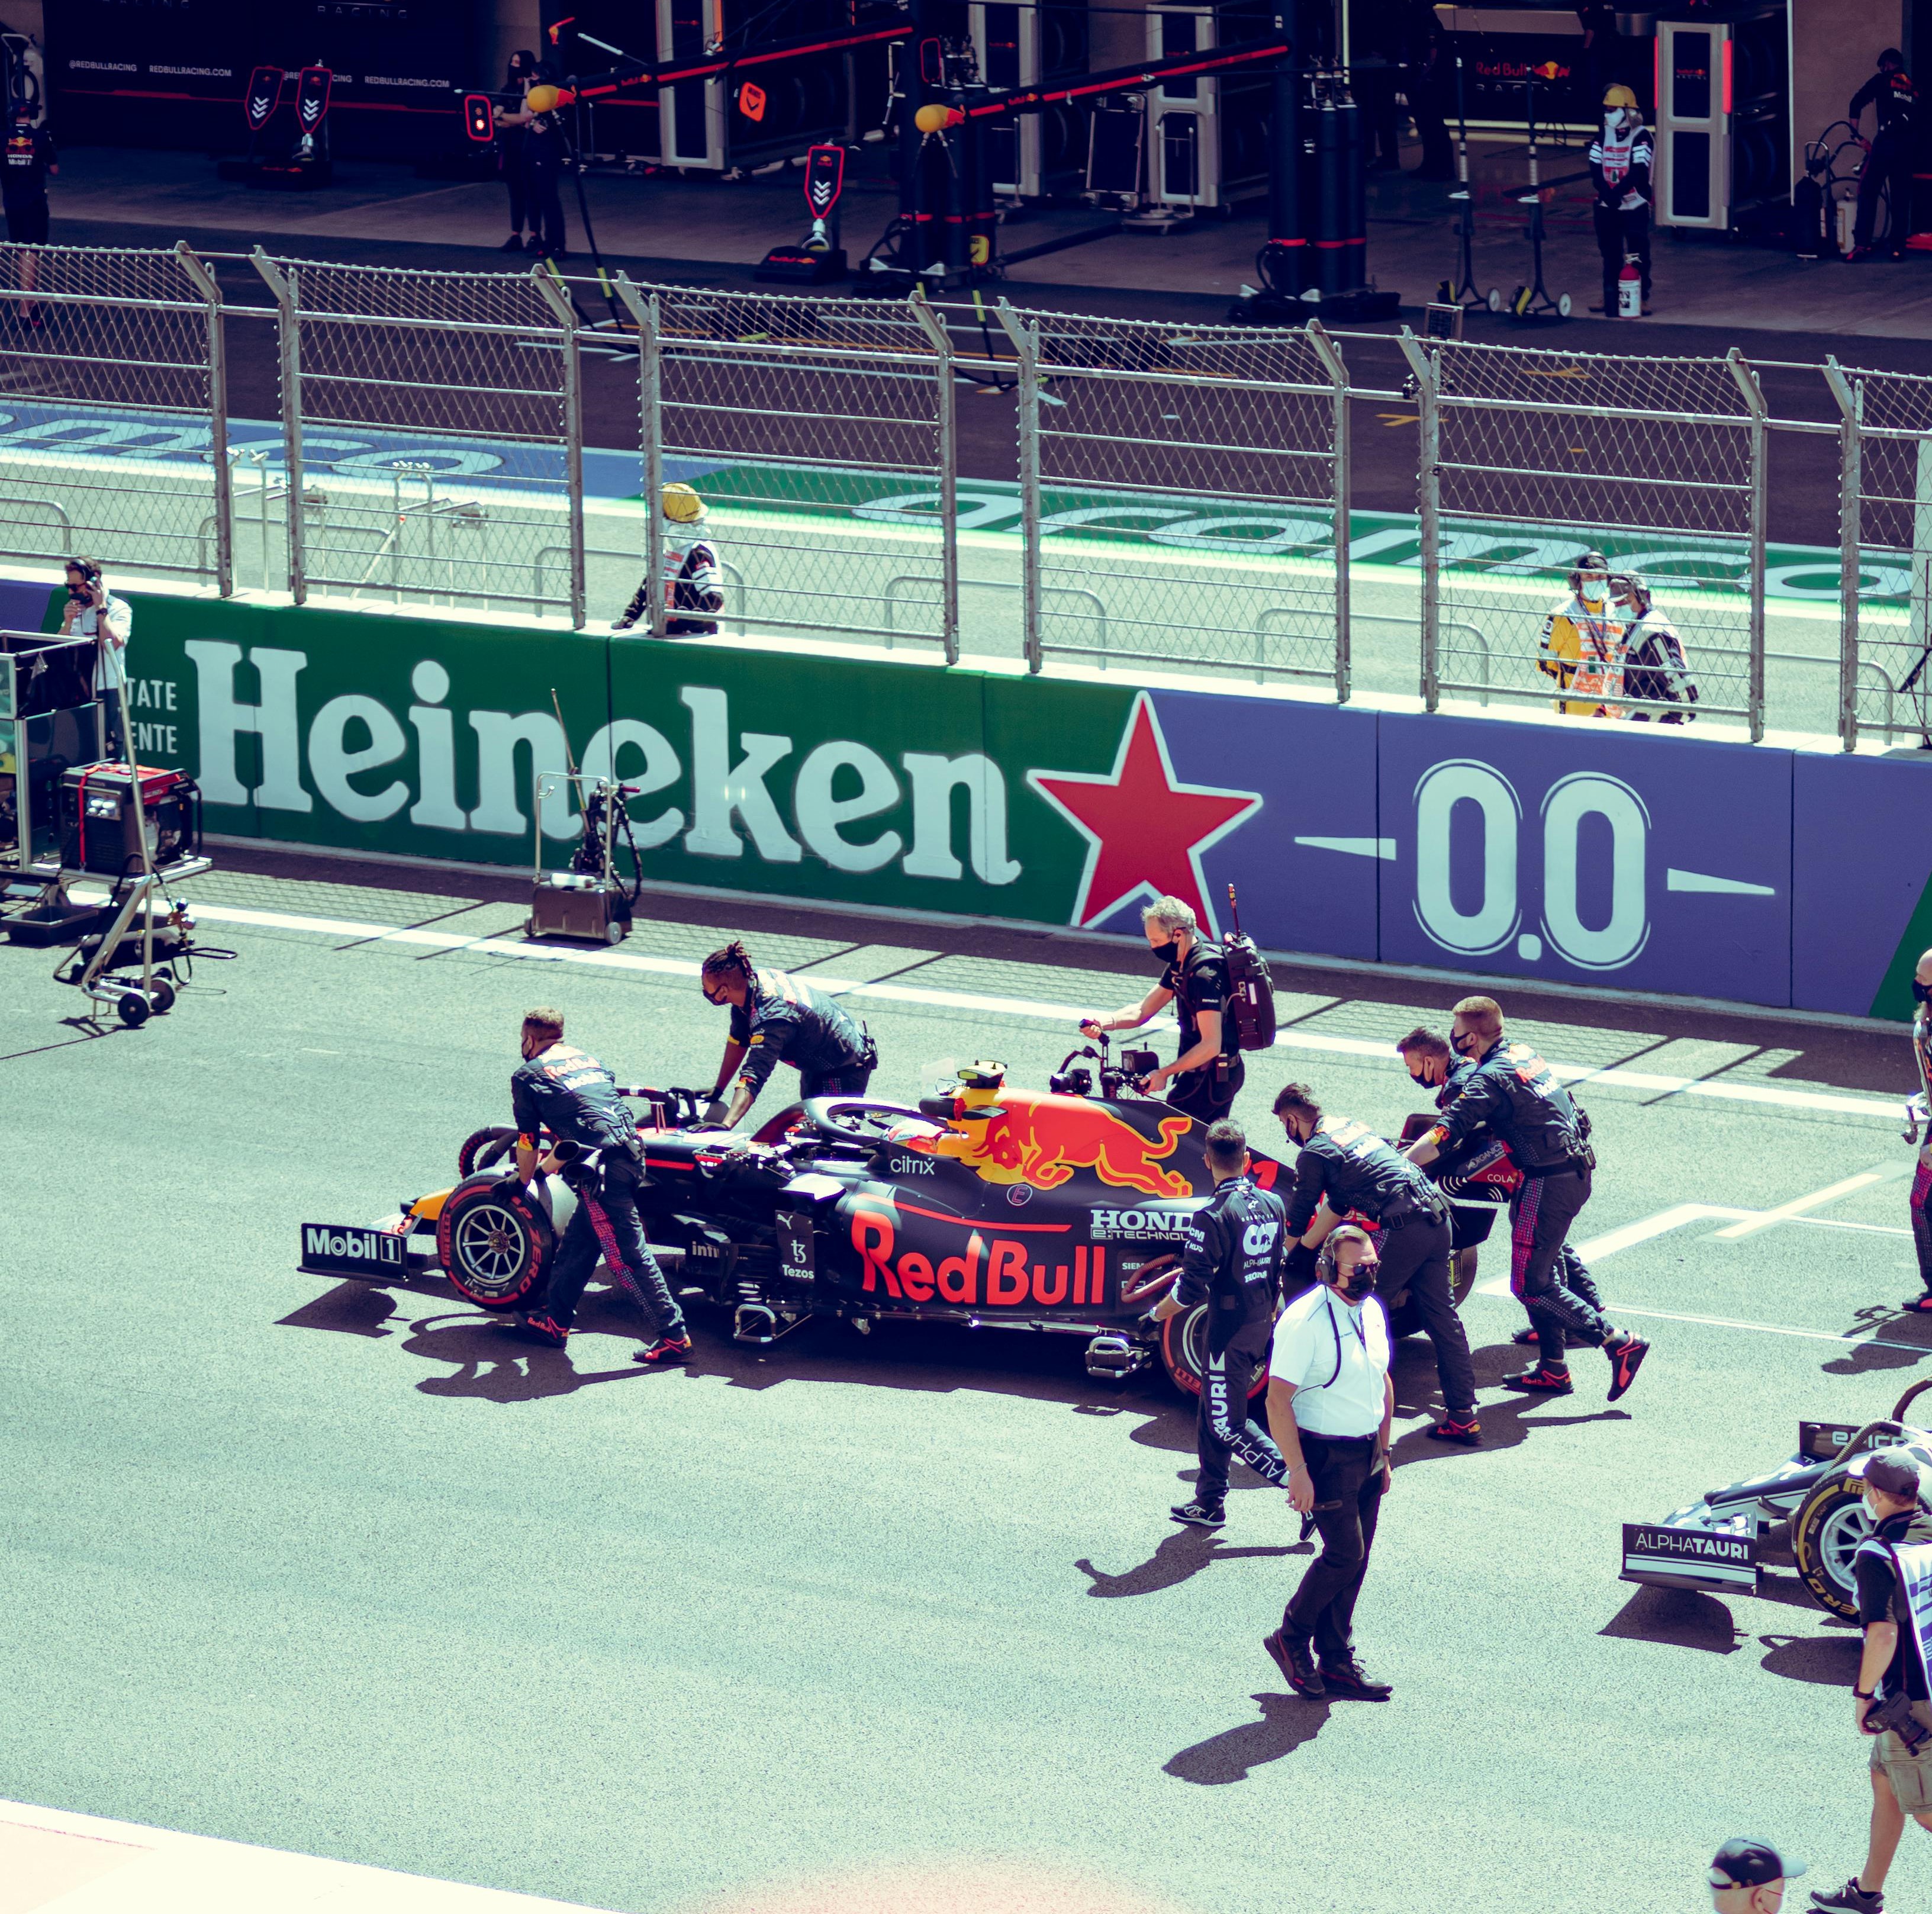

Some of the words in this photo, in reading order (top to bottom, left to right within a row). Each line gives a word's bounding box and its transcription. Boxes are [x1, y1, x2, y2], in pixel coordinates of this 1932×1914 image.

[69, 60, 137, 72] @REDBULLRACING
[149, 65, 232, 77] REDBULLRACING.COM
[1476, 62, 1501, 76] Red
[365, 76, 450, 88] REDBULLRACING.COM
[184, 639, 1023, 886] Heineken
[1413, 758, 1652, 971] 0.0
[890, 1155, 935, 1175] citrix
[1487, 1173, 1514, 1183] COLA
[1090, 1209, 1194, 1231] HOND
[306, 1227, 378, 1260] Mobil
[851, 1208, 983, 1304] Red
[987, 1239, 1106, 1305] Bull
[782, 1264, 814, 1279] Tezos
[1635, 1532, 1749, 1560] ALPHATAURI
